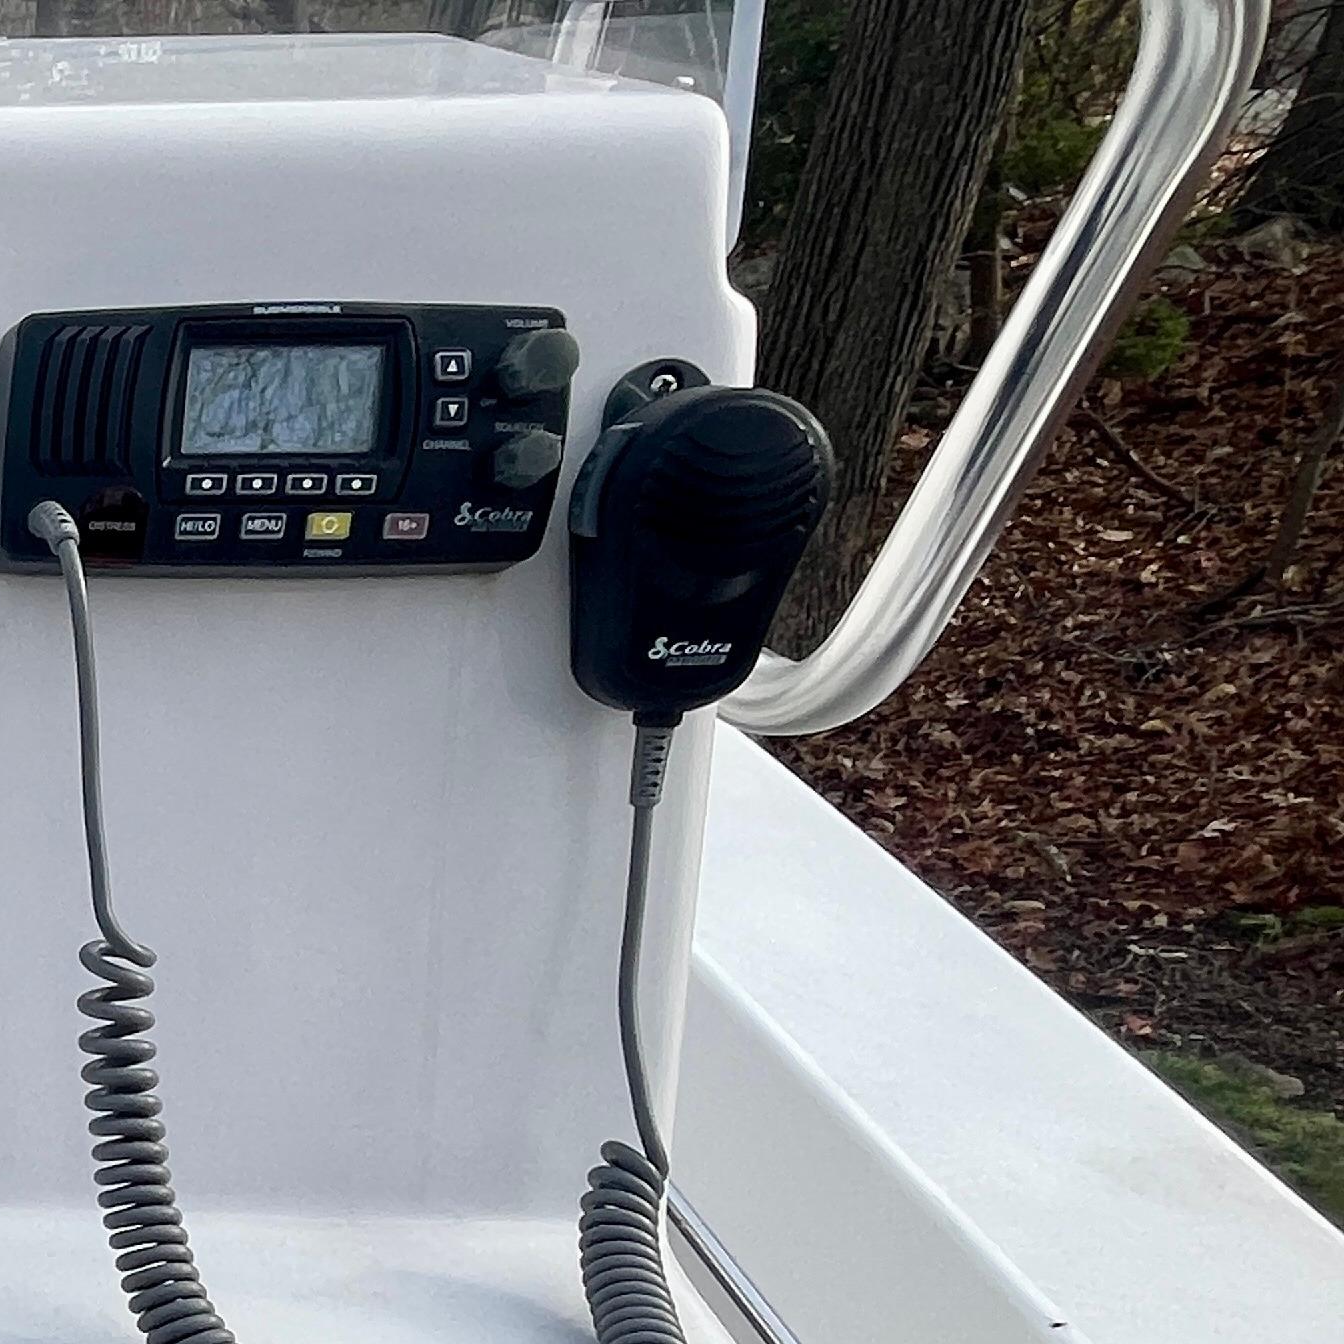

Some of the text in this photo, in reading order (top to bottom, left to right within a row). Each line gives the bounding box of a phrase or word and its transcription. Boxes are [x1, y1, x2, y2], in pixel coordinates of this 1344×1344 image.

[422, 439, 471, 451] CHANNEL
[474, 507, 533, 523] Cobra
[246, 519, 282, 532] MENU
[669, 639, 732, 656] Cobra
